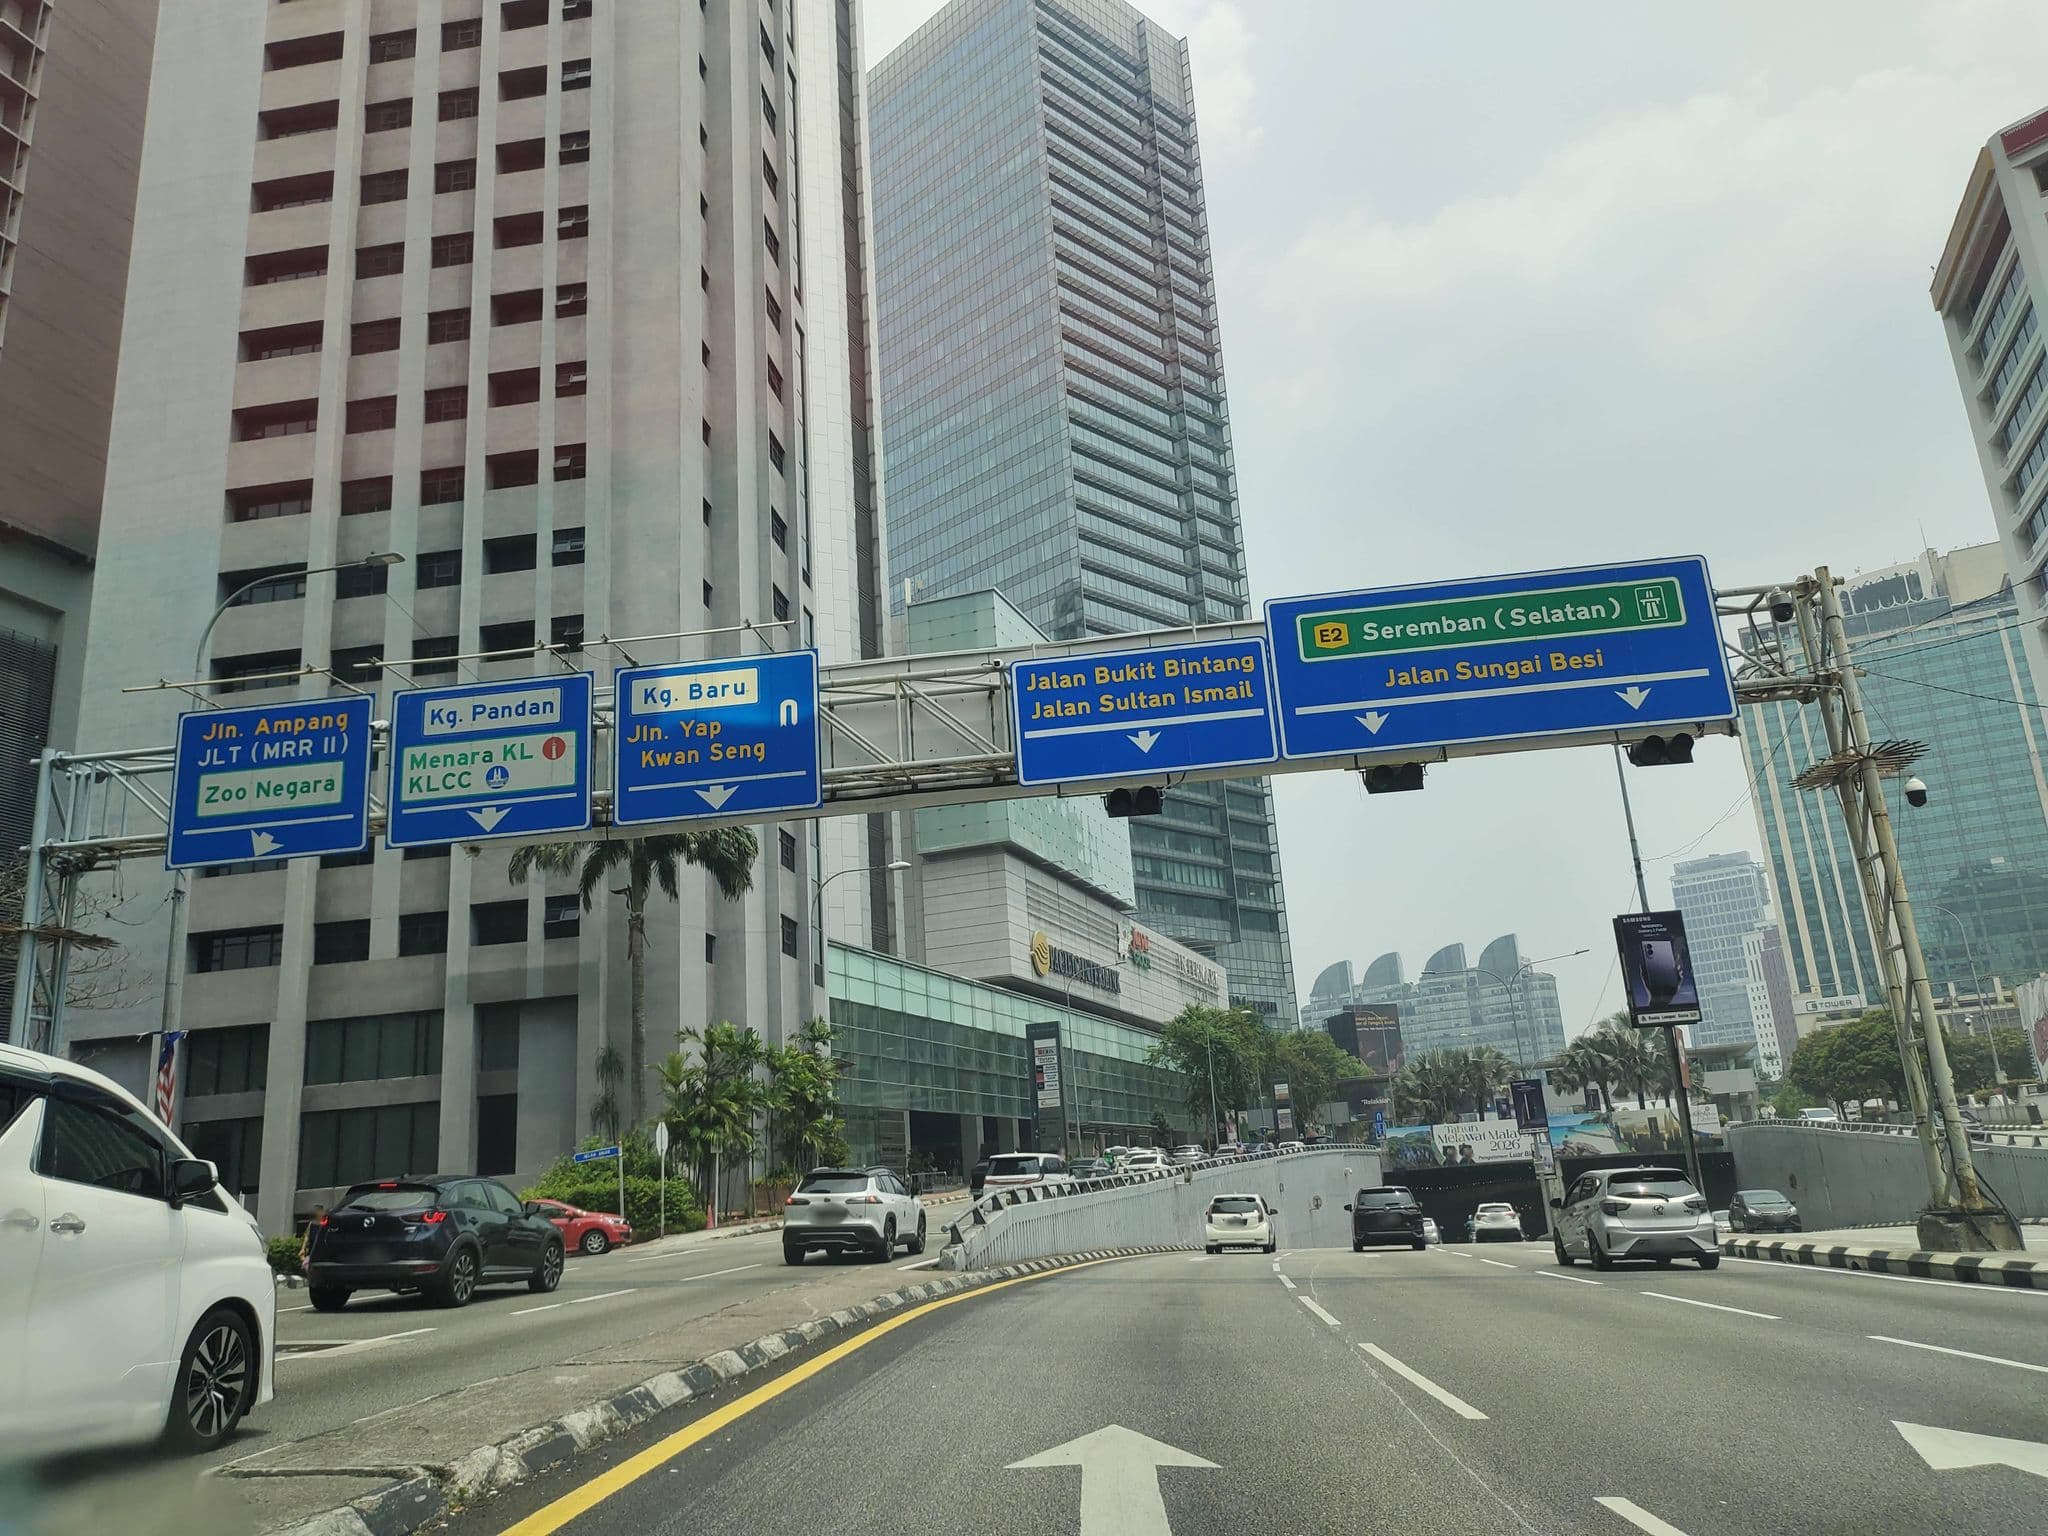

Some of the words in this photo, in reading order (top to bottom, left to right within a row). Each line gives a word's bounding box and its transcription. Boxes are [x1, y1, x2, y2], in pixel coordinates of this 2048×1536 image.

[1319, 627, 1343, 643] E2
[1362, 615, 1487, 642] Seremban
[1493, 597, 1622, 630] (Selatan)
[1026, 671, 1086, 692] Jalan
[1094, 662, 1156, 685] Bukit
[1163, 655, 1255, 677] Bintang
[1385, 667, 1449, 688] Jalan
[1455, 655, 1542, 681] Sungai
[1550, 648, 1604, 671] Besi
[643, 686, 679, 708] Kg.
[689, 682, 746, 700] Baru
[1031, 699, 1091, 720] Jalan
[1099, 691, 1176, 713] Sultan
[1184, 680, 1254, 704] Ismail
[202, 722, 244, 741] Jln.
[254, 712, 349, 735] Ampang
[430, 707, 464, 729] Kg.
[471, 700, 554, 722] Pandan
[626, 724, 669, 744] Jln.
[679, 719, 722, 739] Yap
[197, 745, 243, 767] JLT
[251, 738, 314, 763] (MRR
[410, 750, 493, 771] Menara
[502, 743, 534, 761] KL
[641, 749, 700, 768] Kwan
[709, 741, 766, 763] Seng
[204, 785, 247, 804] Zoo
[255, 778, 336, 800] Negara
[408, 771, 473, 794] KLCC
[1819, 999, 1853, 1009] TOWER
[1437, 1132, 1486, 1144] Melawat
[1445, 1124, 1479, 1134] Tahun
[1489, 1139, 1521, 1152] 2026
